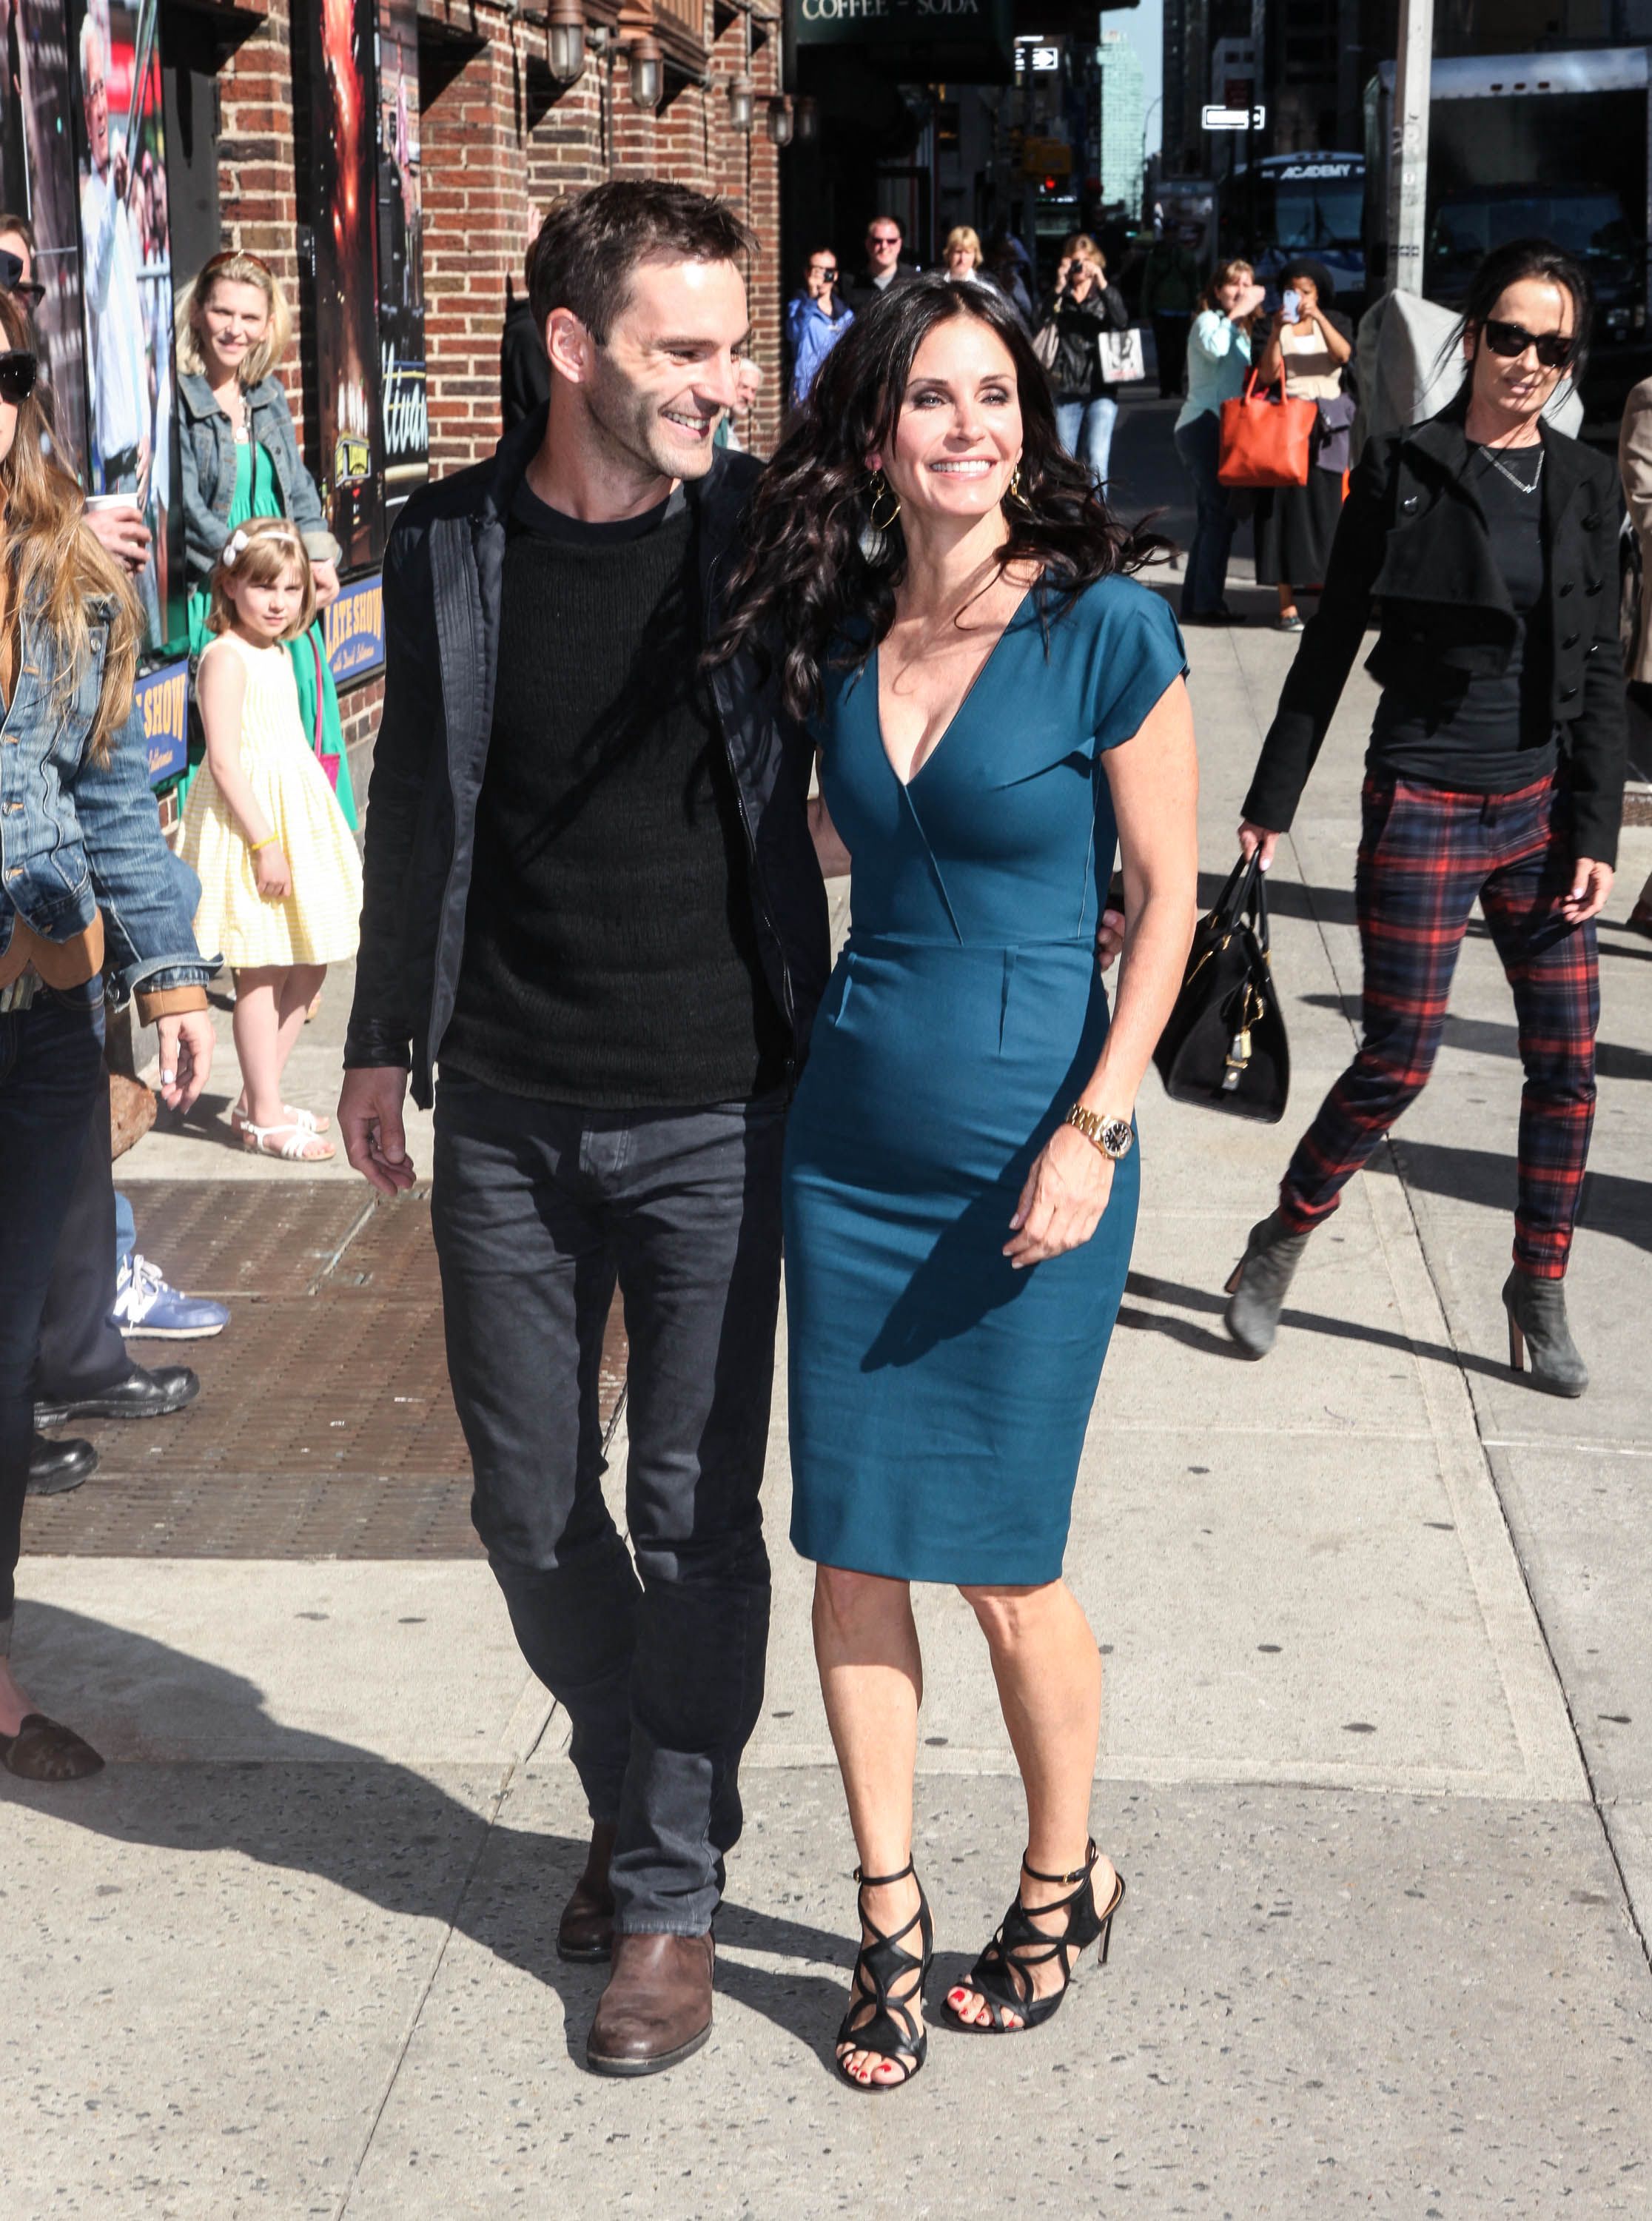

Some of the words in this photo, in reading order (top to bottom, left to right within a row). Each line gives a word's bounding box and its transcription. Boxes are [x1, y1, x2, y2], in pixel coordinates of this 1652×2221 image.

[802, 0, 888, 20] COFFEE
[917, 0, 978, 14] SODA
[1280, 164, 1350, 180] ACADEMY
[326, 597, 352, 664] LATE
[353, 586, 383, 640] SHOW
[144, 673, 186, 743] SHOW
